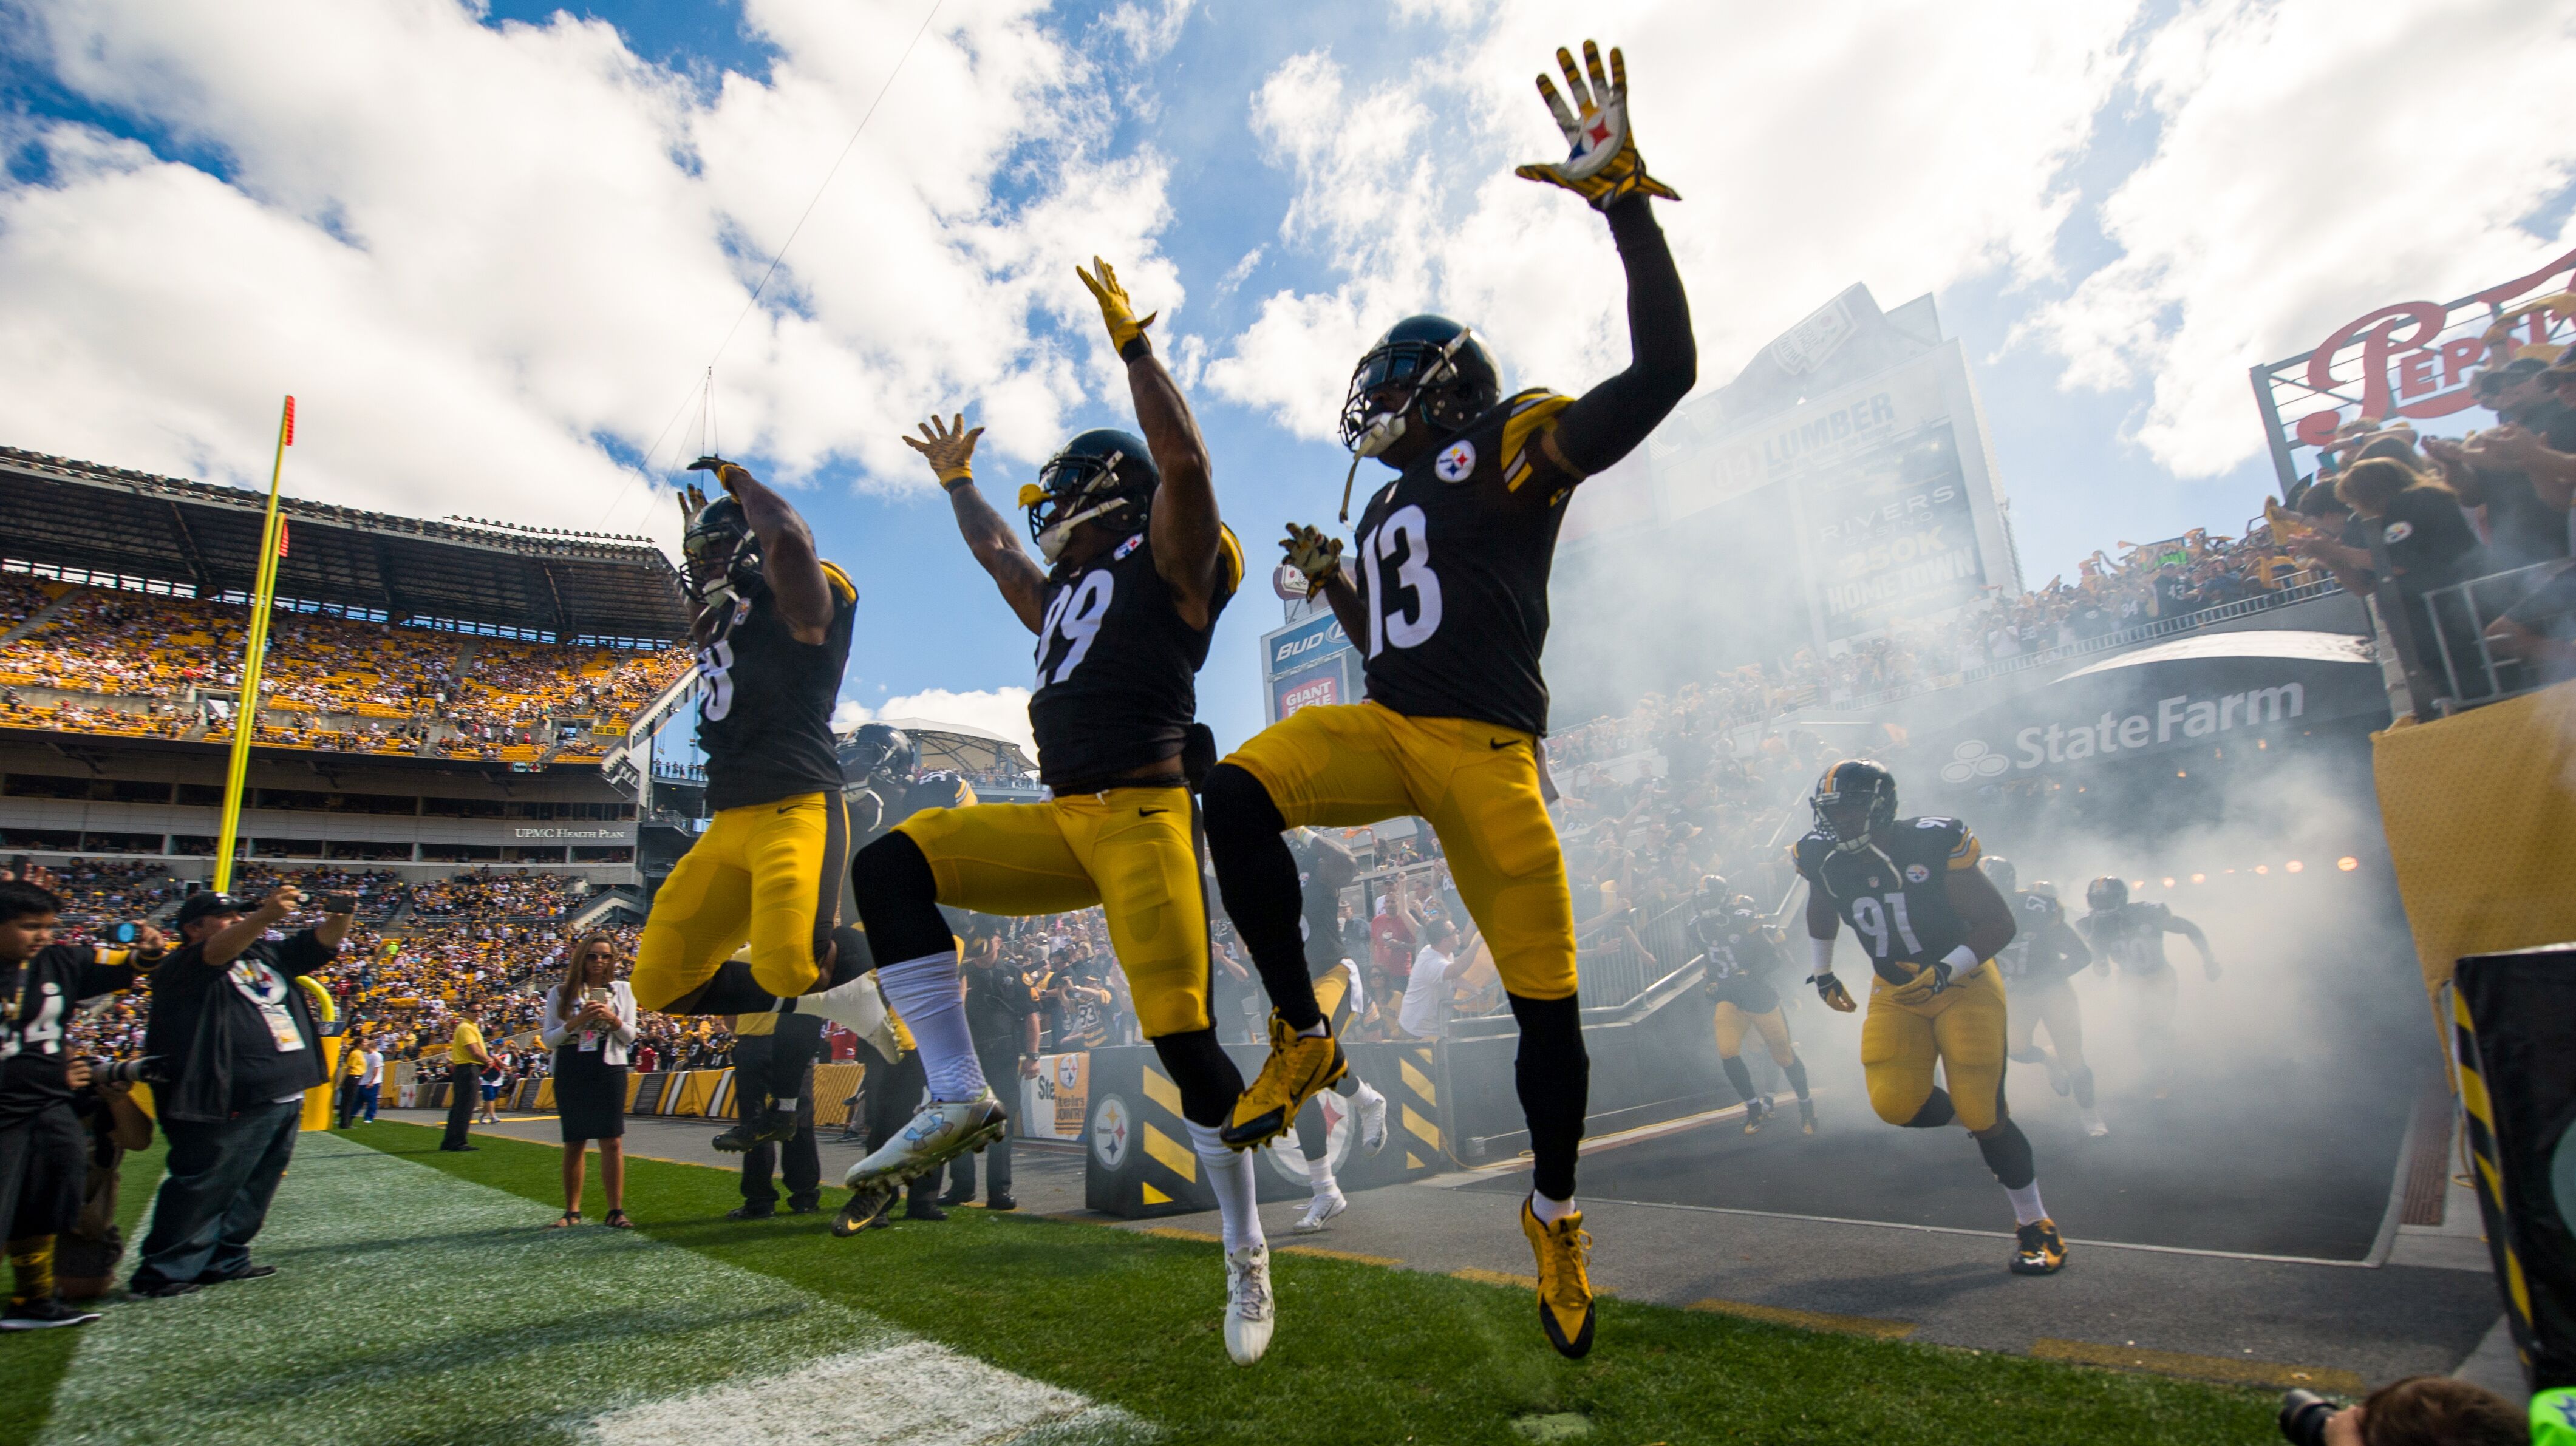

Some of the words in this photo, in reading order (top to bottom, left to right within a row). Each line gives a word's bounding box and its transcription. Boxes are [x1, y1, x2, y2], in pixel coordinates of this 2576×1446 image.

[1763, 392, 1895, 467] LUMBER
[1820, 485, 1954, 542] RIVERS
[1845, 511, 1934, 546] CASINO
[1362, 504, 1443, 661] 13
[1276, 631, 1324, 662] BUD
[1286, 681, 1331, 706] GIANT
[515, 829, 554, 838] UPMC
[556, 829, 597, 838] HEALTH
[598, 829, 625, 838] PLAN
[1852, 892, 1923, 957] 91
